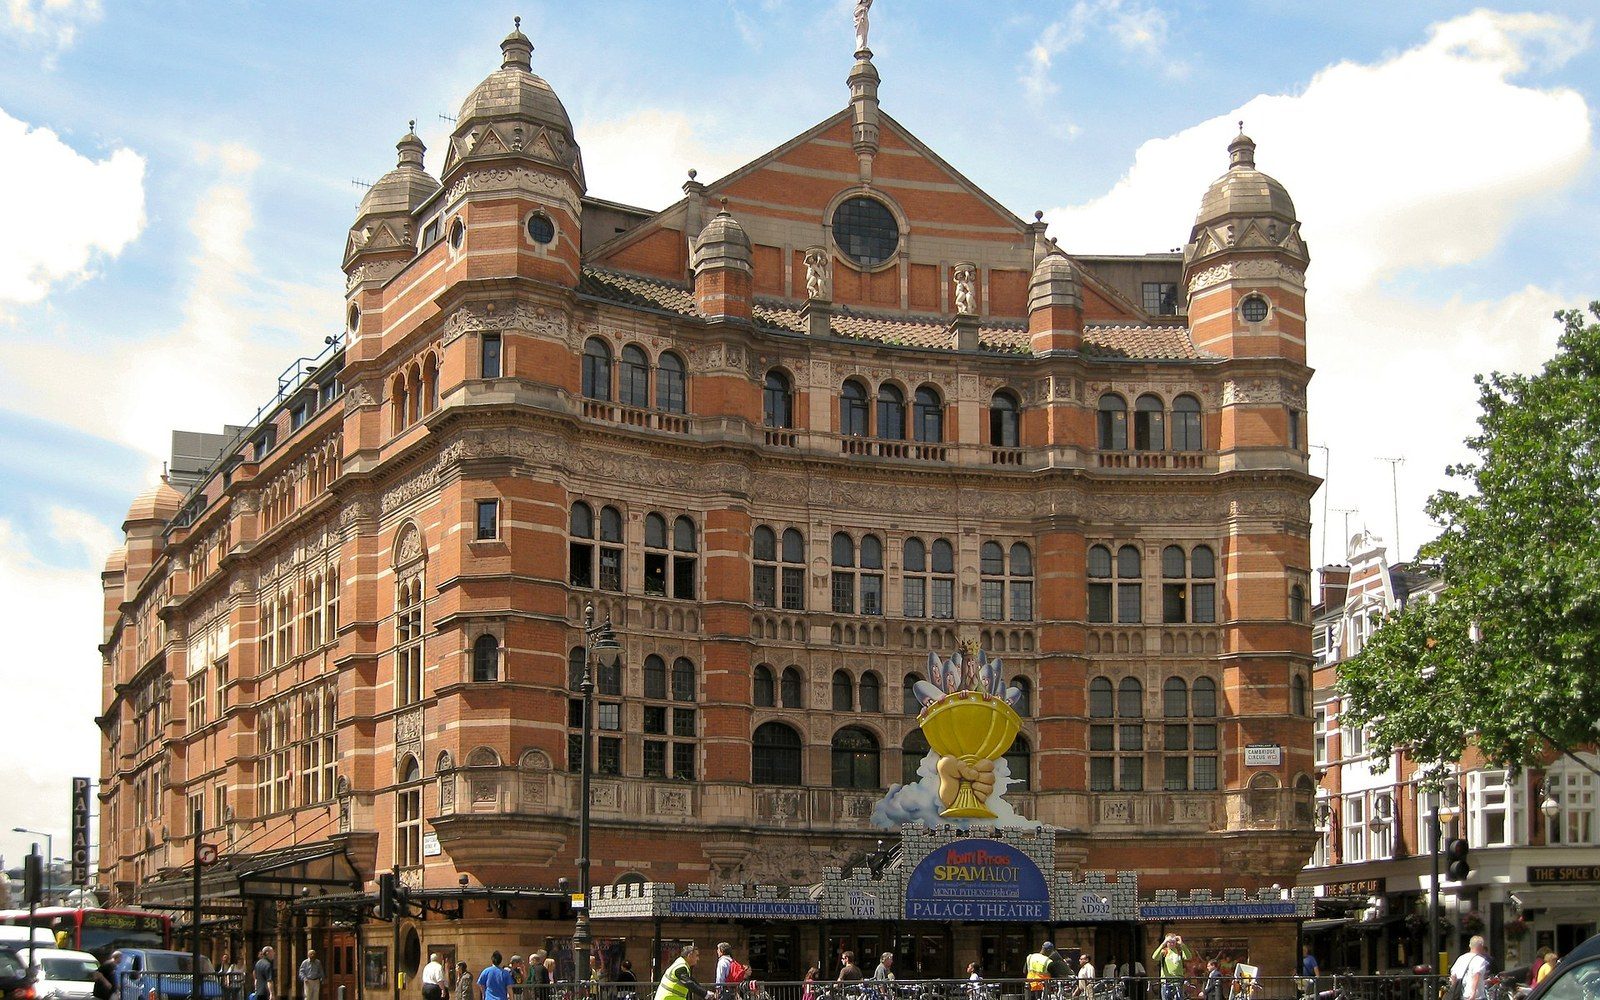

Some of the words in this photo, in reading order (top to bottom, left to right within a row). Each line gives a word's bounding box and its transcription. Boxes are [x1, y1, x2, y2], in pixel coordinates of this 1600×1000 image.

[74, 779, 87, 882] PALACE
[933, 865, 1020, 882] SPAMALOT
[1535, 868, 1555, 880] THE
[1559, 868, 1589, 880] SPICE
[933, 888, 958, 897] MONTY
[959, 888, 985, 897] PYTHON
[1325, 884, 1338, 895] THE
[849, 896, 875, 906] 1075TH
[670, 901, 709, 913] FUNNIER
[711, 901, 738, 913] THAN
[739, 902, 756, 914] THE
[758, 902, 785, 914] BLACK
[789, 903, 818, 915] DEATH
[849, 906, 876, 916] YEAR
[912, 902, 973, 917] PALACE
[976, 903, 1043, 918] THEATRE
[1158, 907, 1186, 916] MUSICAL
[1186, 906, 1212, 915] THEATRE
[1214, 906, 1231, 914] BACK
[1237, 905, 1271, 914] THOUSAND
[143, 917, 158, 928] 38
